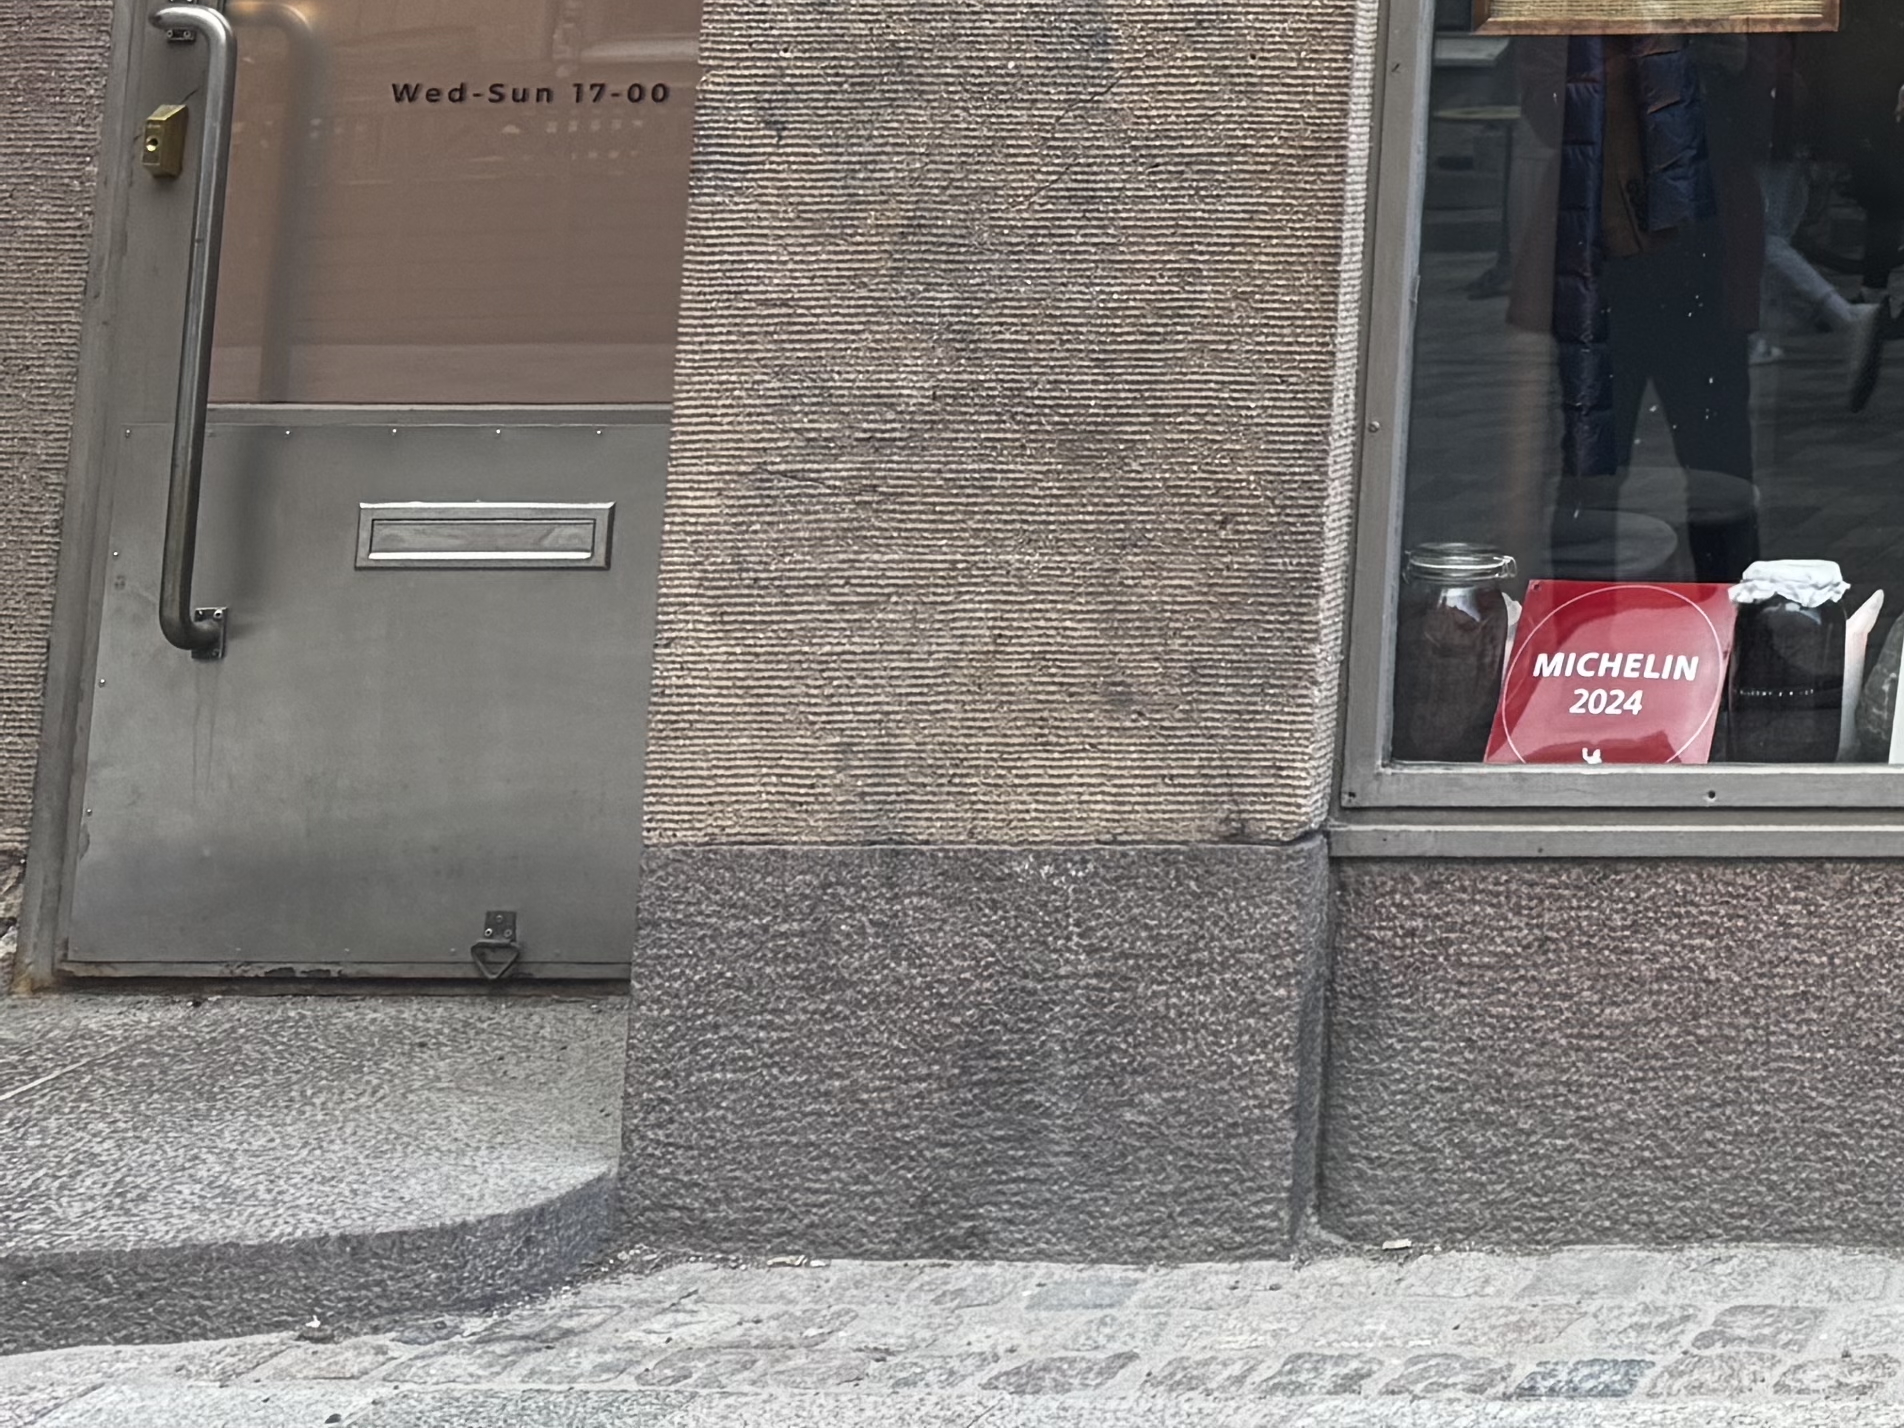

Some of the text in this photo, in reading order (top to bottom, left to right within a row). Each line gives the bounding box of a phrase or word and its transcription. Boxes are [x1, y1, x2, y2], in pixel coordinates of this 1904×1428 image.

[391, 82, 672, 104] Wed-Sun 17-00
[1532, 651, 1699, 681] MICHELIN
[1568, 688, 1644, 716] 2024
